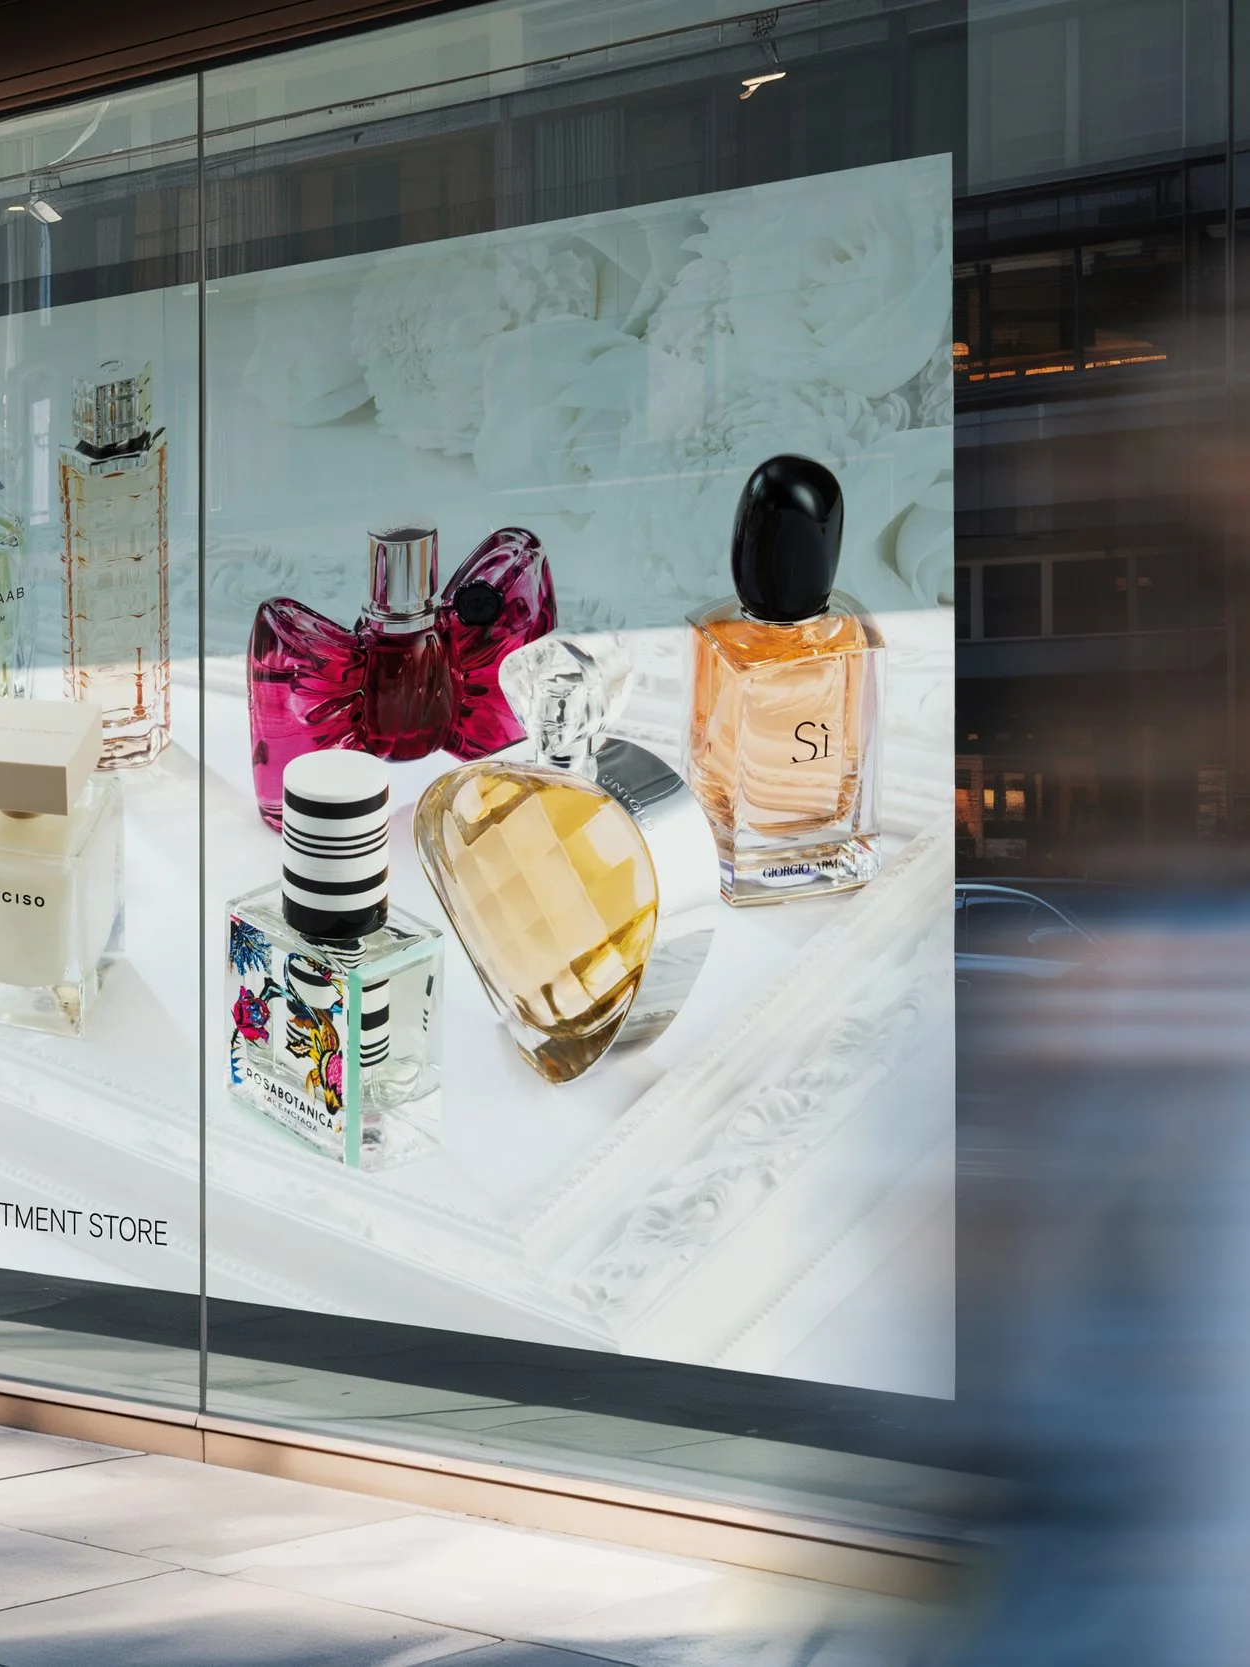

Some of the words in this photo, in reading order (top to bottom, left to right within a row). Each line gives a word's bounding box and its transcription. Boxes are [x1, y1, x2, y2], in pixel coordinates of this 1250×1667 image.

[762, 862, 810, 878] GIORGIO
[246, 1067, 333, 1130] ROSABOTANICA
[89, 1212, 168, 1247] STORE
